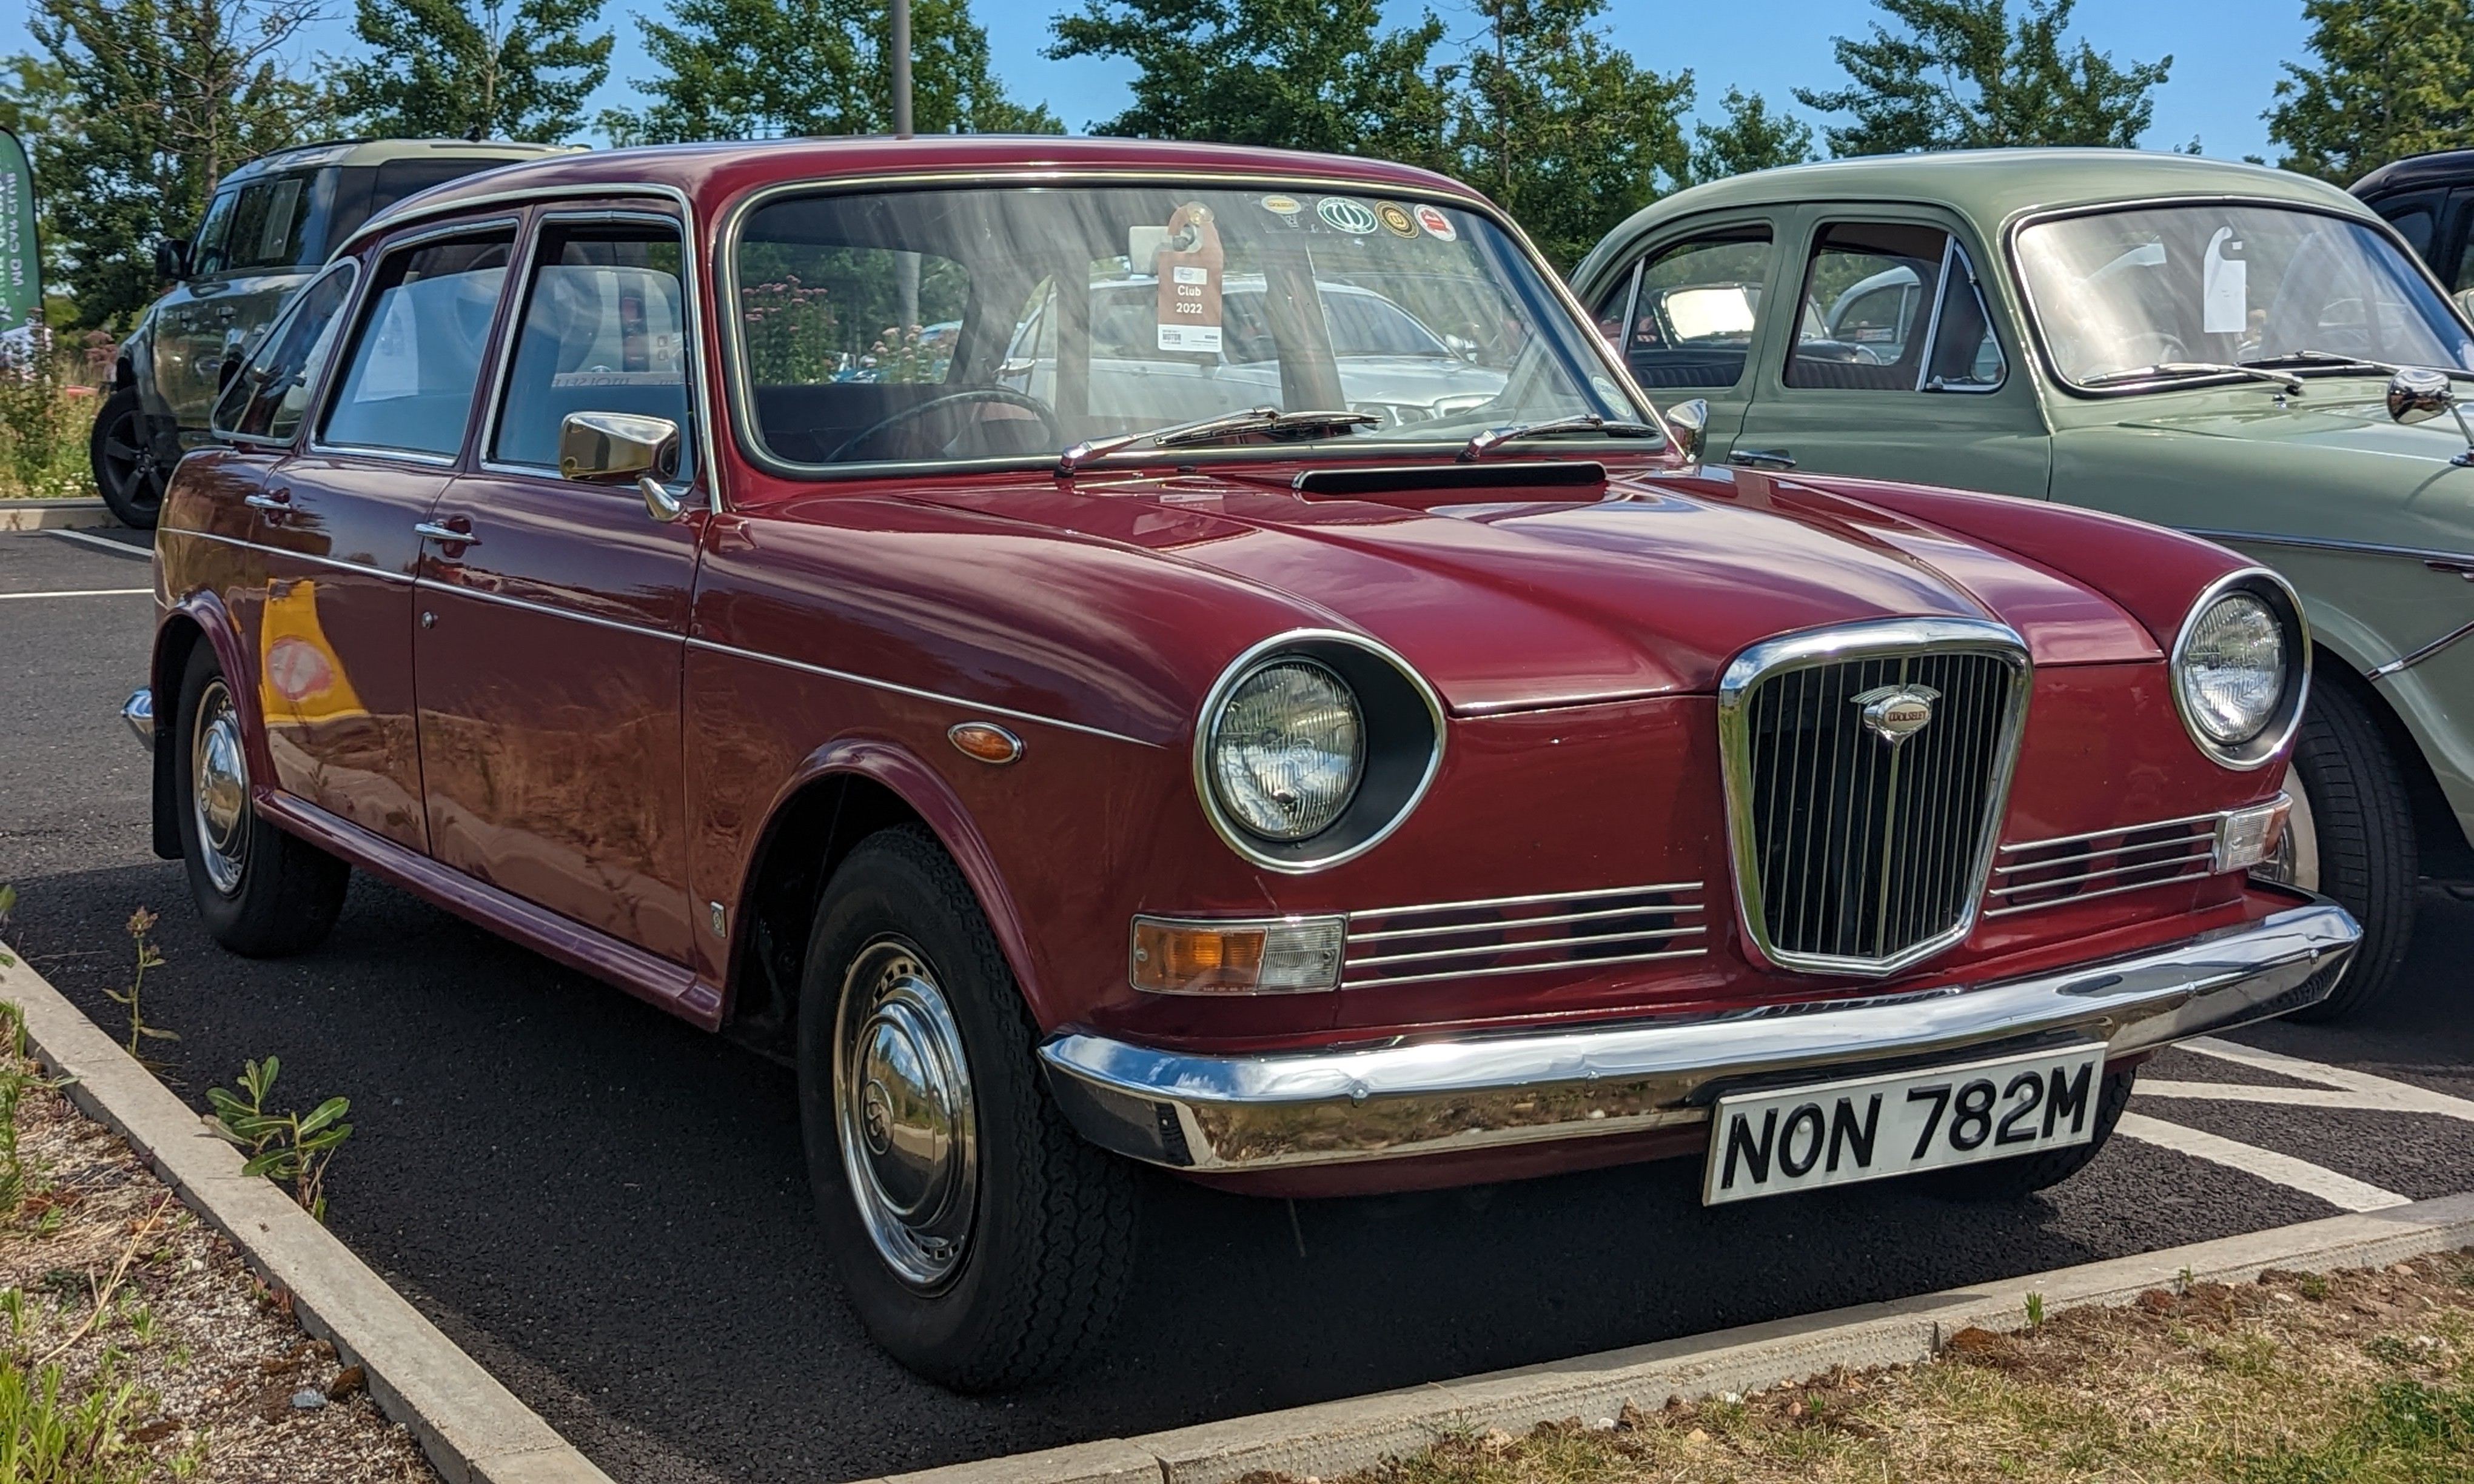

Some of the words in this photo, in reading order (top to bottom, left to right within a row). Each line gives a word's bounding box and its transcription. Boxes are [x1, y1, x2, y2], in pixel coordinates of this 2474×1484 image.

[1178, 286, 1201, 296] Club
[1176, 302, 1202, 313] 2022
[1888, 710, 1926, 722] WOLSELEY
[1720, 1093, 1883, 1189] NON
[1906, 1061, 2096, 1160] 782M
